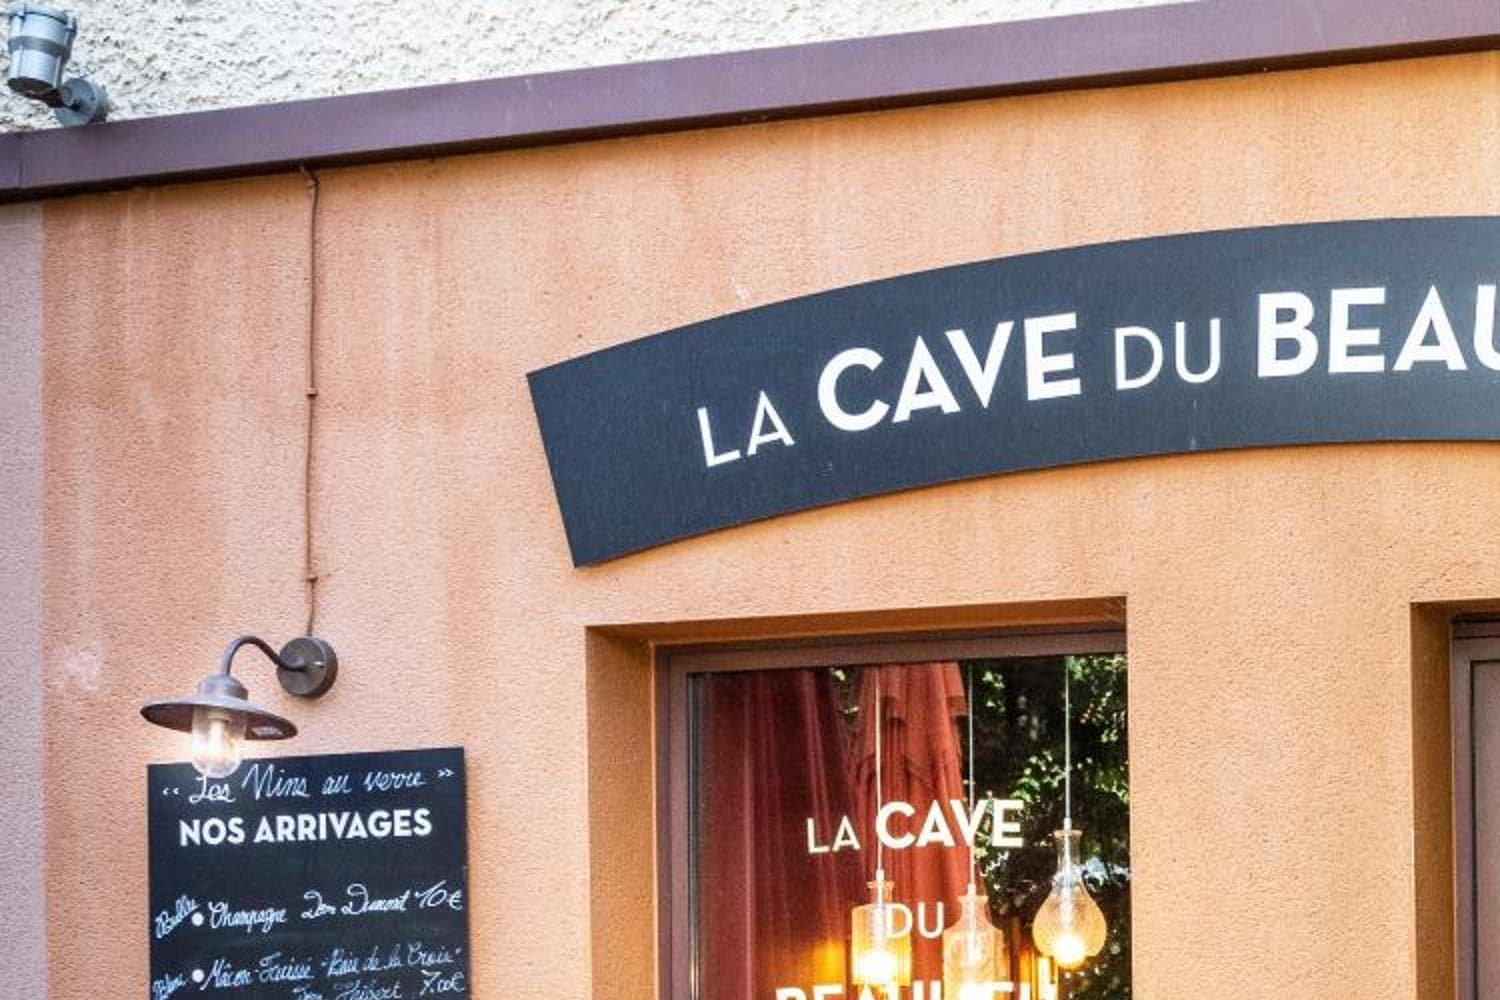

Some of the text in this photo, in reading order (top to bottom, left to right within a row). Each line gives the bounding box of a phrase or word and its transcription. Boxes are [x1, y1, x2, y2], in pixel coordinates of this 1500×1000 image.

[698, 391, 794, 467] LA
[818, 312, 1081, 431] CAVE
[1115, 318, 1220, 390] DU
[322, 774, 352, 794] au
[180, 808, 432, 846] NOS ARRIVAGES
[806, 799, 1024, 853] LA CAVE
[884, 902, 944, 939] DU
